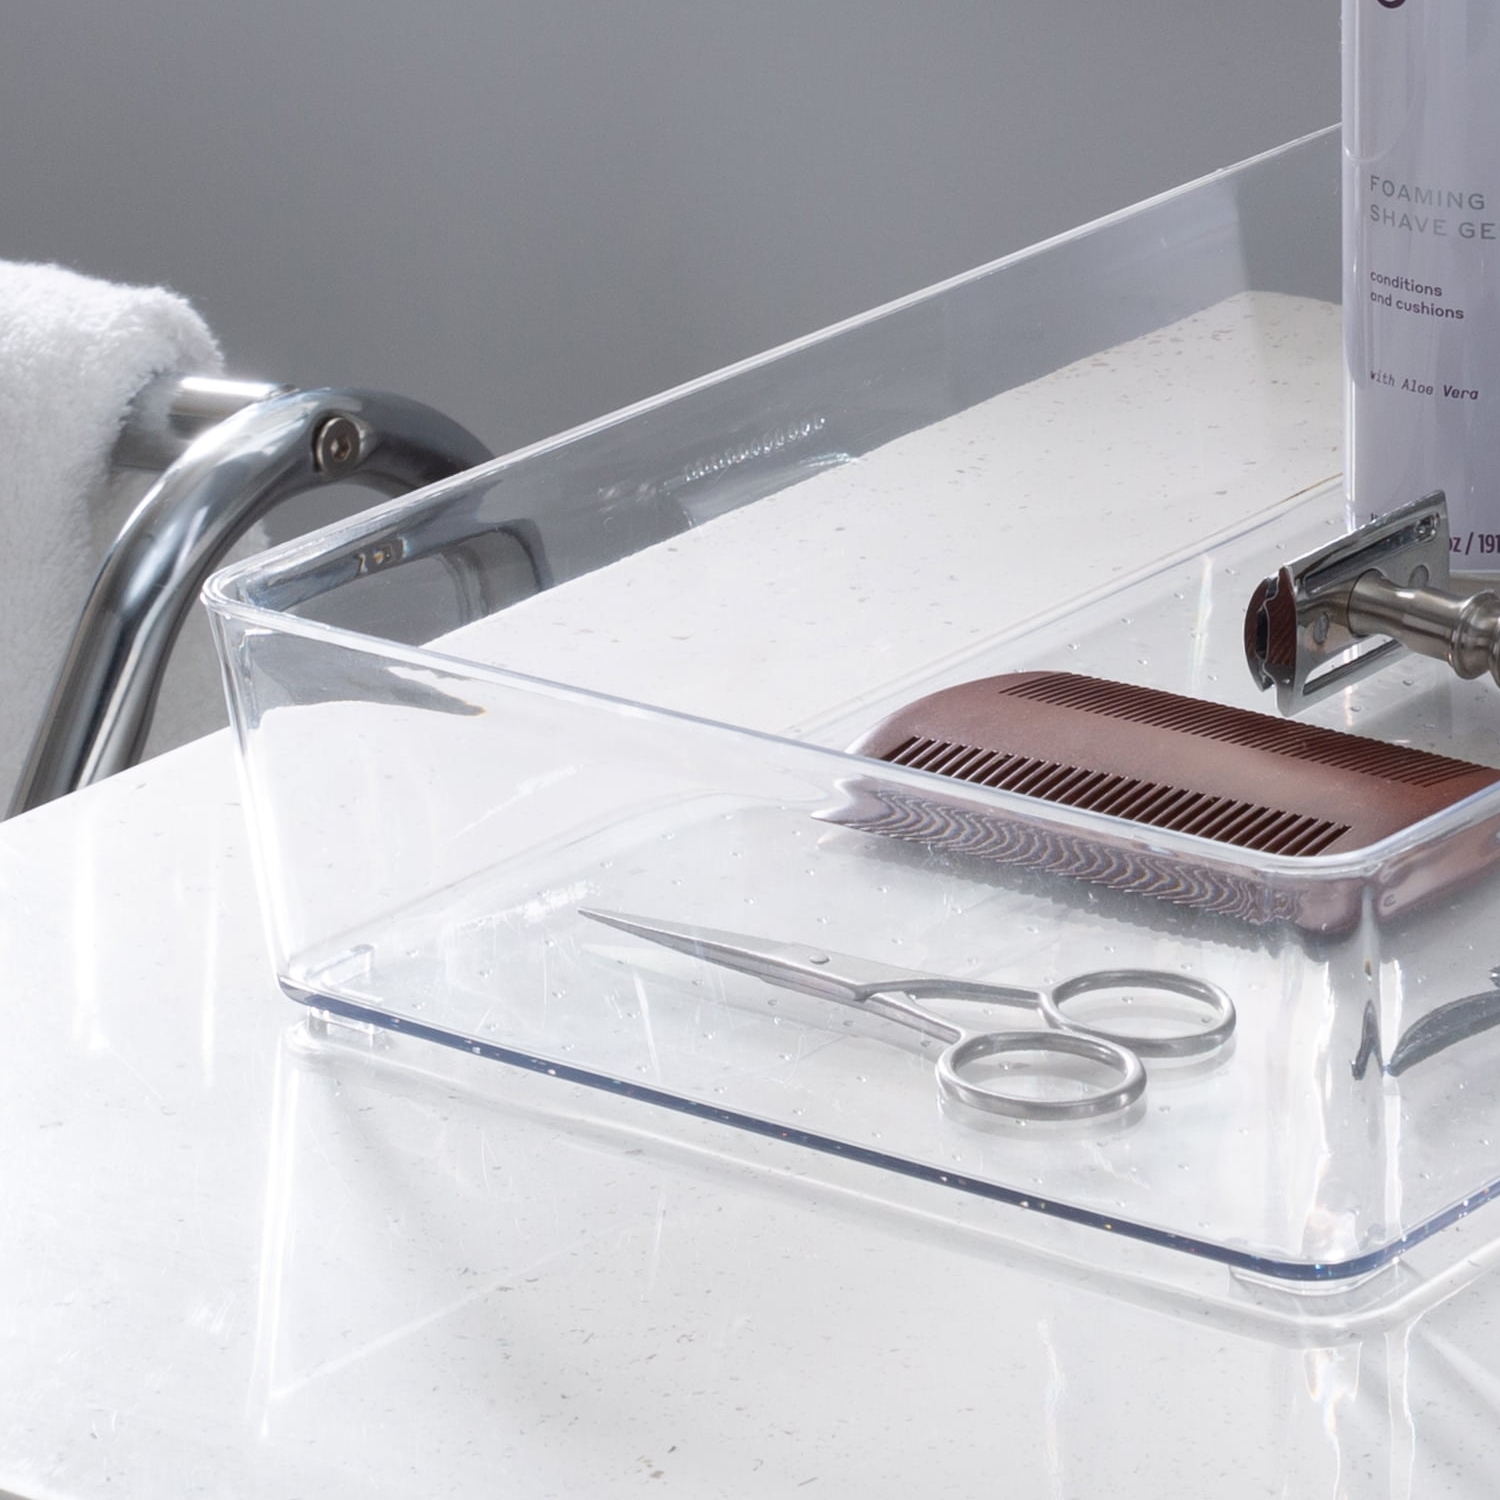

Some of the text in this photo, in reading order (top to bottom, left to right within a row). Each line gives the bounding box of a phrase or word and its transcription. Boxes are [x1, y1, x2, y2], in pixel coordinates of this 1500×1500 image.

[1370, 174, 1486, 210] FOAMING
[1370, 204, 1448, 236] SHAVE
[1370, 271, 1442, 297] conditions
[1370, 290, 1465, 319] and cushions
[1370, 370, 1479, 400] with Aloe Vera
